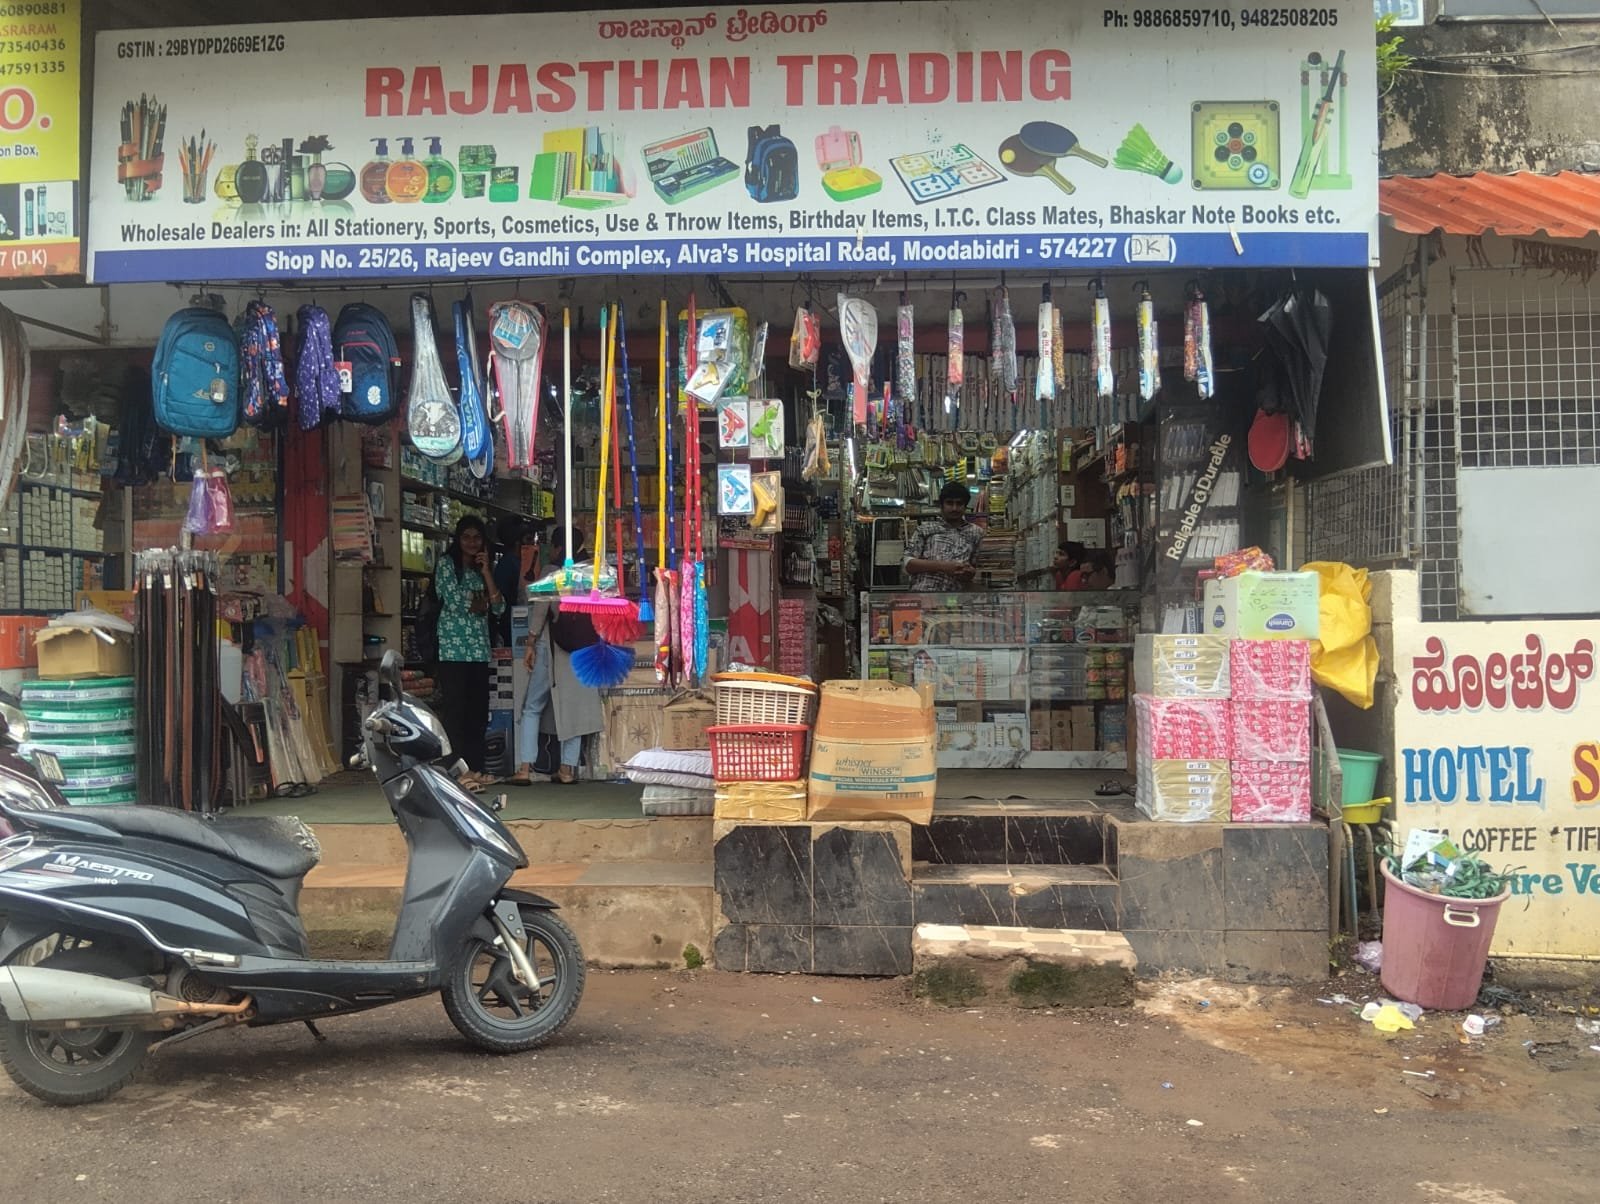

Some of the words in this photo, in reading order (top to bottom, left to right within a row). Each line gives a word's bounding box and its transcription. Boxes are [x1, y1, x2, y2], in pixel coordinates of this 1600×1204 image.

[599, 13, 716, 49] ರಾಜಸ್ಥಾನ್
[726, 8, 827, 41] ಟ್ರೇಡಿಂಗ್
[1104, 10, 1128, 28] Ph:
[1133, 9, 1236, 31] 9886859710,
[1241, 9, 1338, 28] 9482508205
[0, 60, 66, 75] 47591335
[118, 40, 155, 59] GSTIN
[365, 56, 751, 118] RAJASTHAN
[776, 48, 1072, 107] TRADING
[15, 145, 40, 158] Box,
[121, 222, 206, 243] Wholesale
[211, 220, 275, 240] Dealers
[280, 220, 301, 238] in:
[306, 219, 329, 237] All
[334, 217, 428, 241] Stationery,
[434, 215, 496, 240] Sports,
[501, 214, 600, 237] Cosmetics,
[605, 212, 641, 233] Use
[646, 213, 659, 231] &
[664, 210, 723, 231] Throw
[727, 209, 783, 233] Items,
[789, 206, 866, 233] Birthday
[872, 206, 930, 231] Items,
[935, 206, 981, 228] I.T.C.
[987, 206, 1037, 226] Class
[1042, 204, 1104, 229] Mates,
[1110, 202, 1185, 225] Bhaskar
[1193, 204, 1237, 225] Note
[1242, 203, 1299, 224] Books
[1305, 203, 1341, 224] etc.
[11, 249, 48, 268] (D.K)
[265, 249, 316, 272] Shop
[321, 247, 353, 269] No.
[358, 246, 419, 271] 25/26,
[424, 248, 493, 274] Rajeev
[499, 245, 570, 267] Gandhi
[576, 244, 671, 269] Complex,
[745, 240, 831, 266] Hospital
[838, 240, 896, 263] Road,
[903, 238, 1020, 262] Moodabidri
[1039, 236, 1117, 259] 574227
[1165, 503, 1203, 560] Reliable
[1196, 433, 1232, 492] Durable
[1411, 633, 1594, 711] ಹೋಟೆಲ್
[1402, 745, 1543, 804] HOTEL
[1463, 827, 1537, 852] COFFEE
